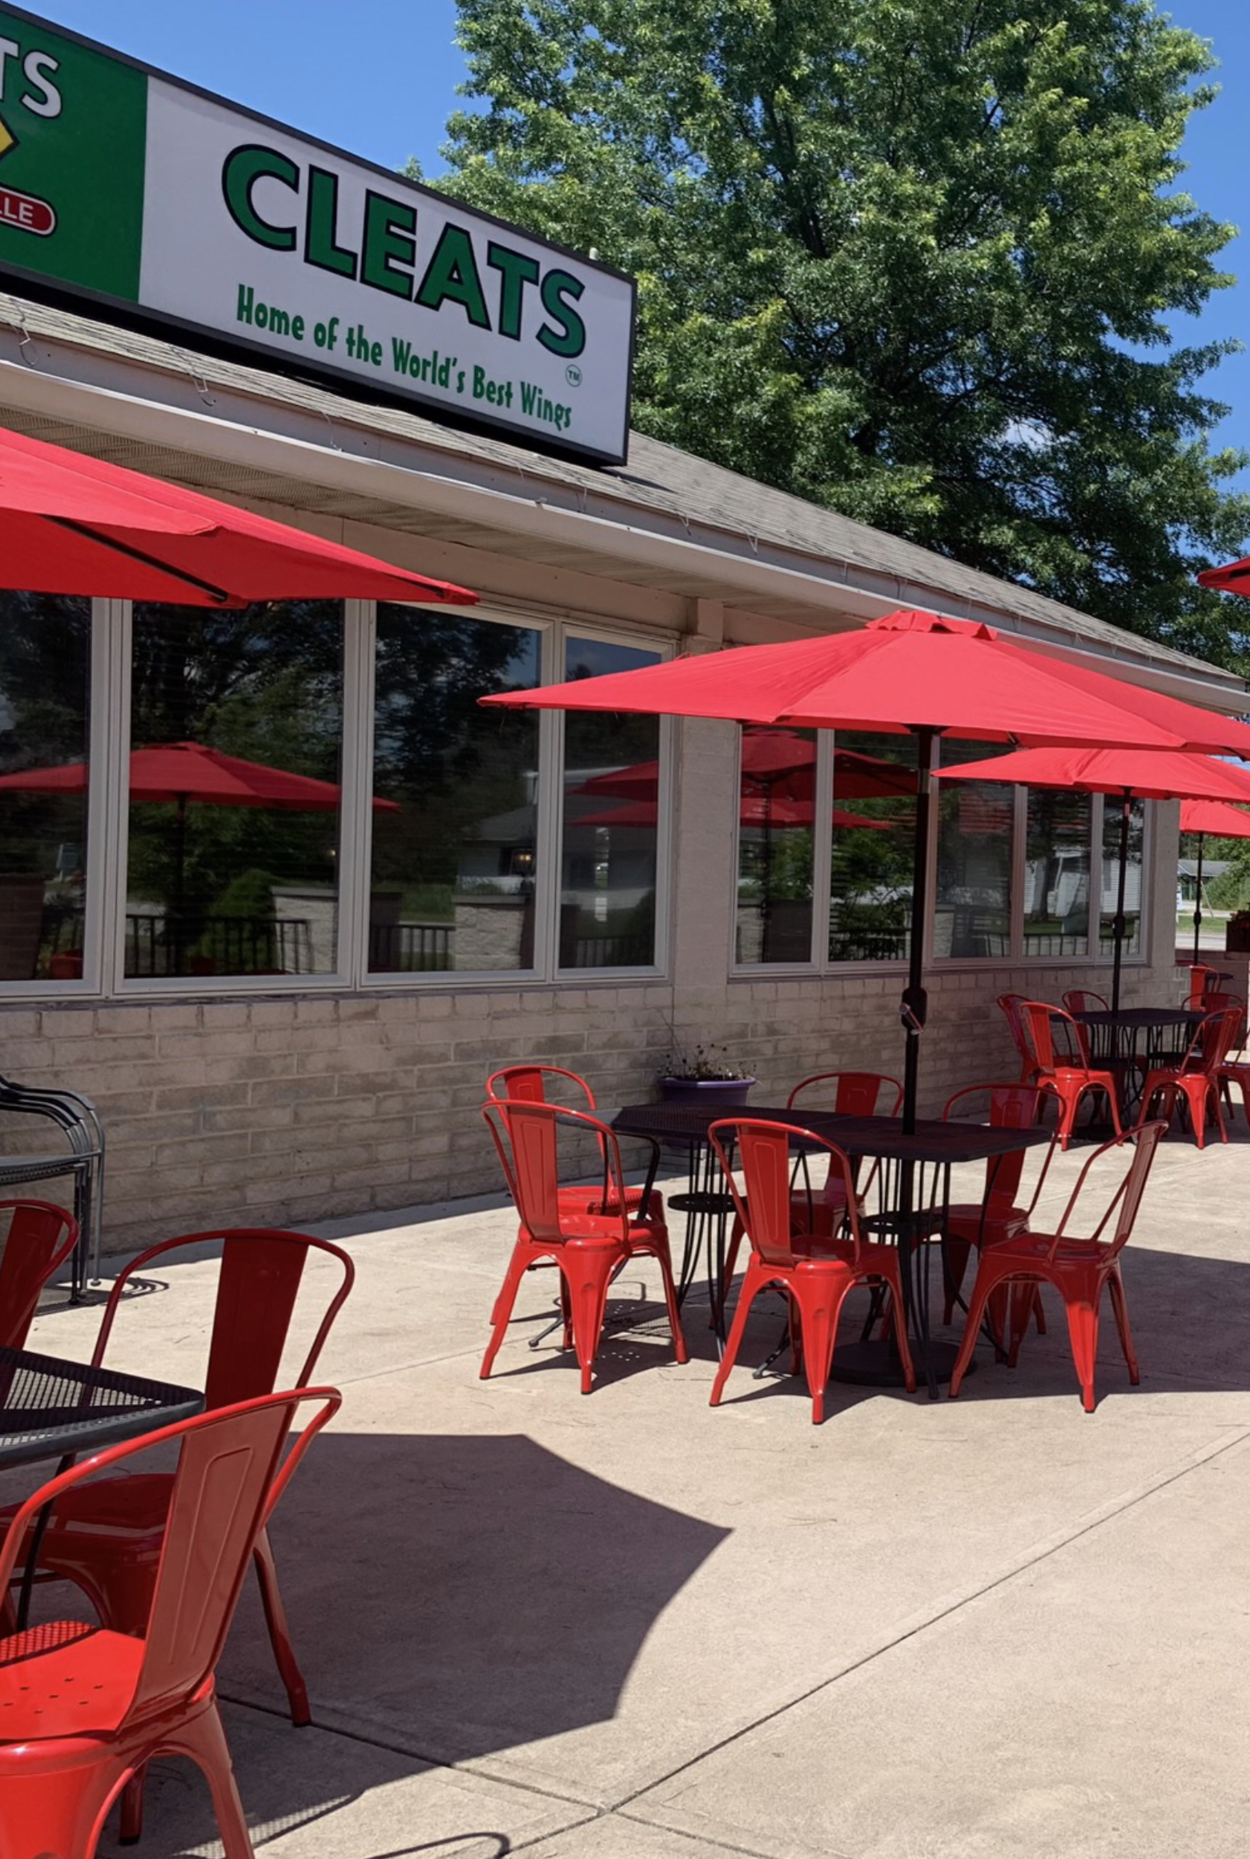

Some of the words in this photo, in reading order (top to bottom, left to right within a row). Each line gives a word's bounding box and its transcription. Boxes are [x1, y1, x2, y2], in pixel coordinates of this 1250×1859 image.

[221, 143, 586, 359] CLEATS
[236, 283, 305, 341] Home
[313, 316, 340, 351] of
[345, 324, 383, 367] the
[391, 336, 466, 394] World's
[472, 364, 514, 409] Best
[519, 380, 572, 432] Wings
